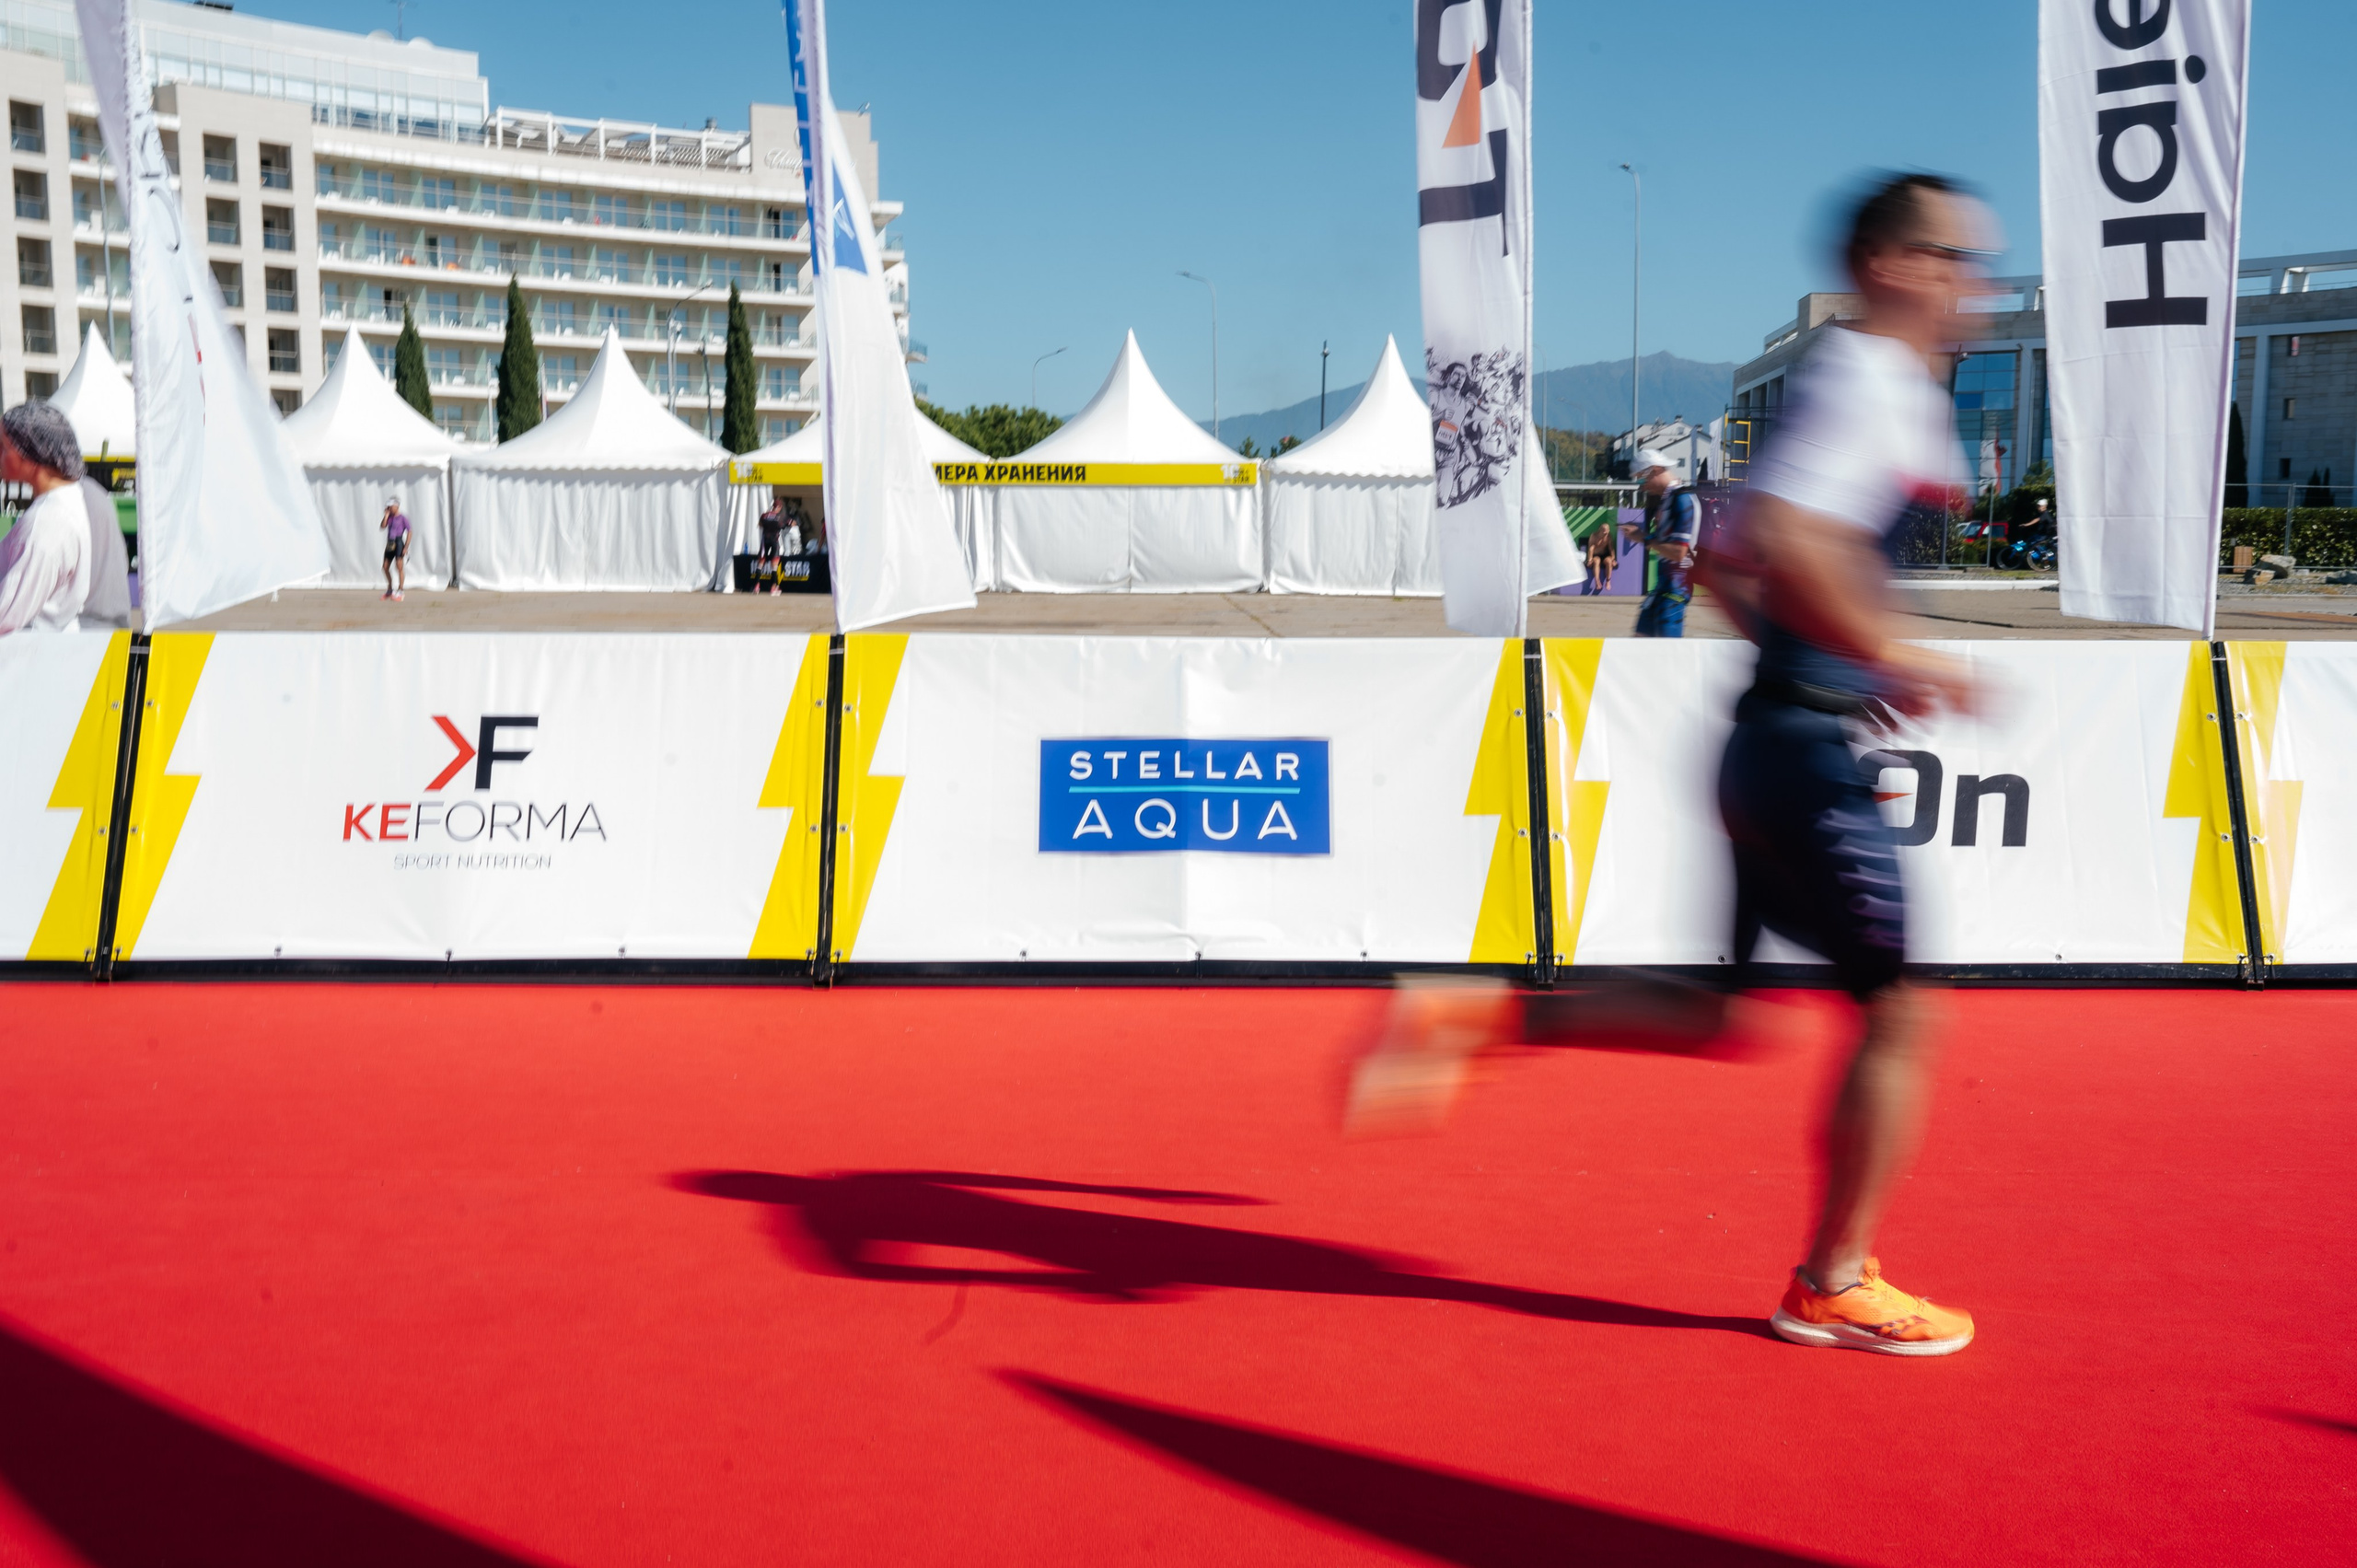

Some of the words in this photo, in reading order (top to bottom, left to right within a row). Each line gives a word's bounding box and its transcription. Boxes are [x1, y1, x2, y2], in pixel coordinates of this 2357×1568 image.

[984, 465, 1086, 481] ХРАНЕНИЯ
[1069, 750, 1300, 781] STELLAR
[343, 800, 607, 842] KEFORMA
[1072, 797, 1298, 841] AQUA
[394, 853, 452, 870] SPORT
[458, 853, 552, 870] NUTRITION
